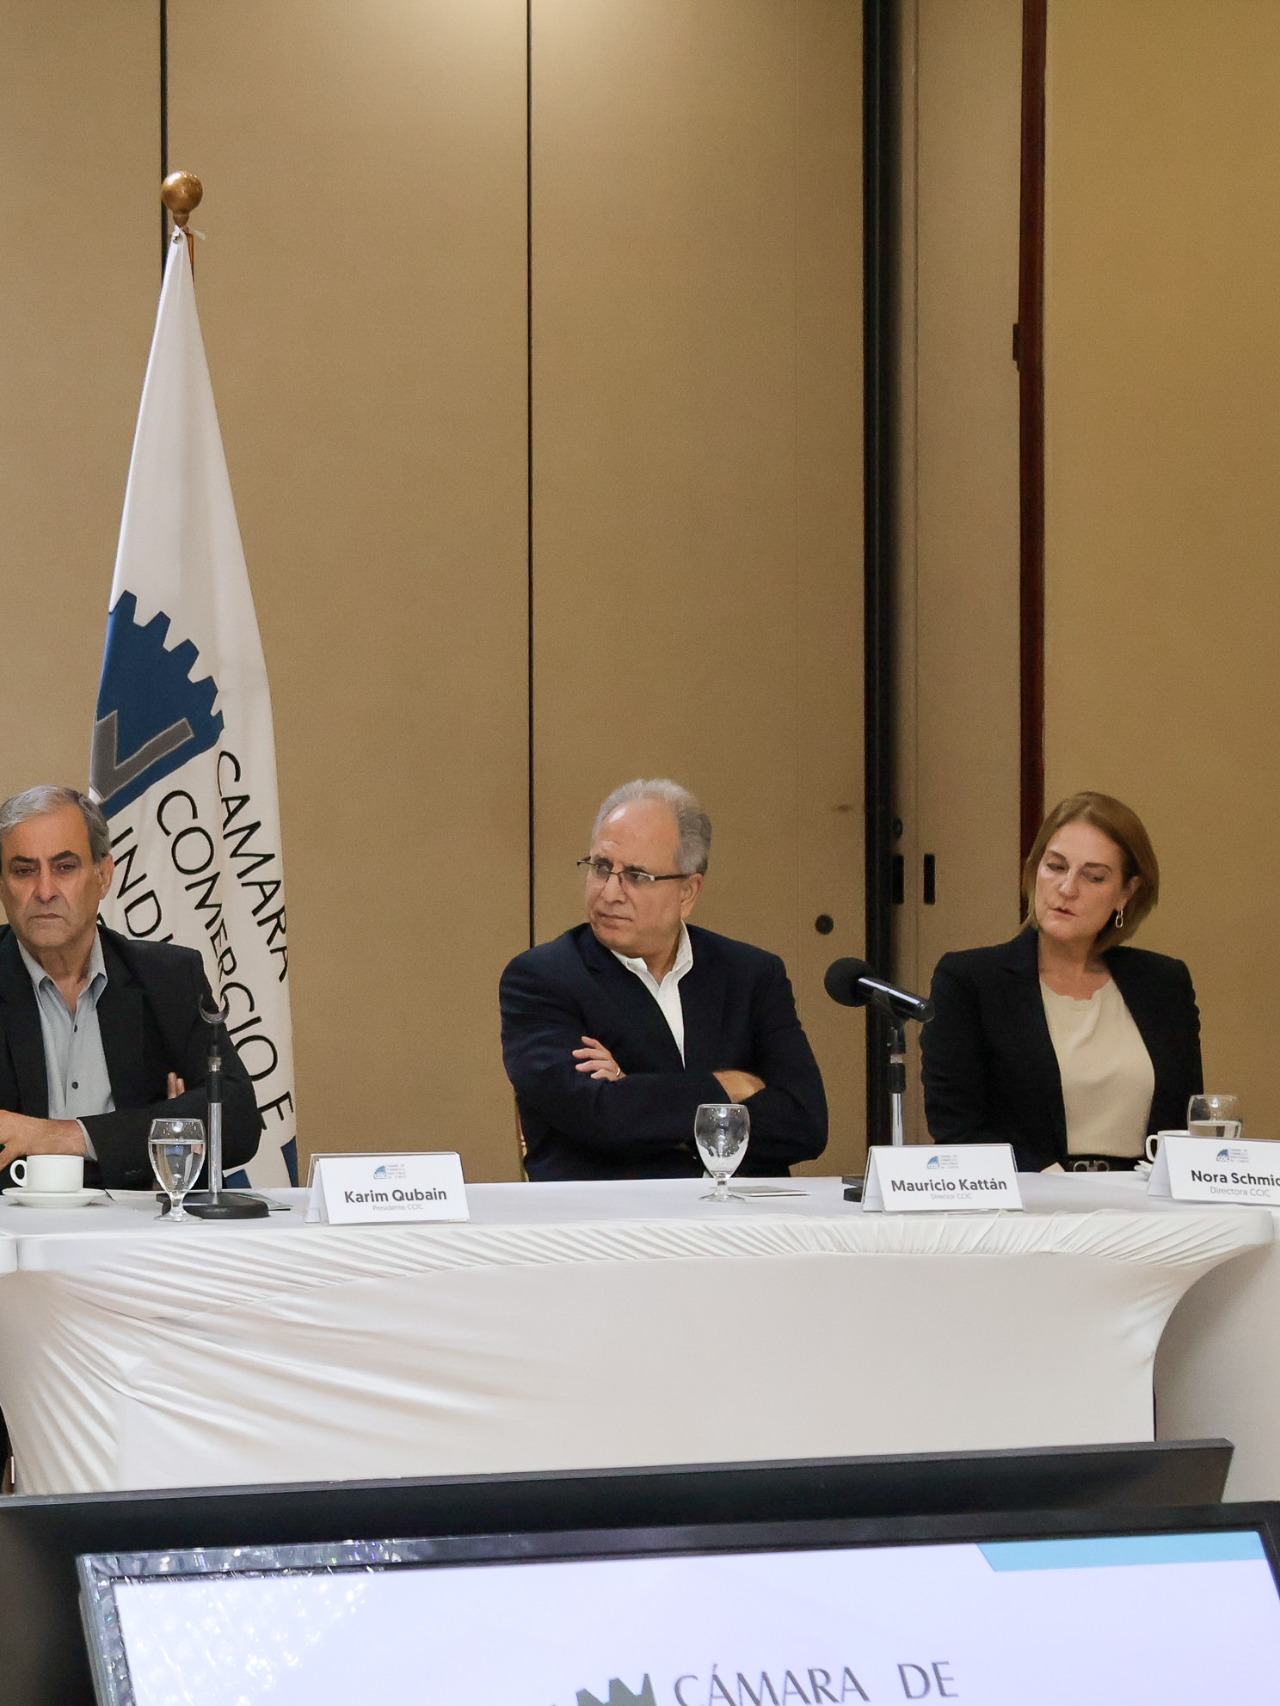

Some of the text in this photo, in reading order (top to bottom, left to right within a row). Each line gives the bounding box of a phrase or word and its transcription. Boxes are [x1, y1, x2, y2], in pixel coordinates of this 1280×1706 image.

[1191, 1170, 1228, 1184] Nora
[891, 1178, 1007, 1192] Mauricio Kattán
[1210, 1186, 1248, 1196] Directora
[344, 1187, 447, 1203] Karim Qubain
[674, 1660, 959, 1706] CÁMARA DE
